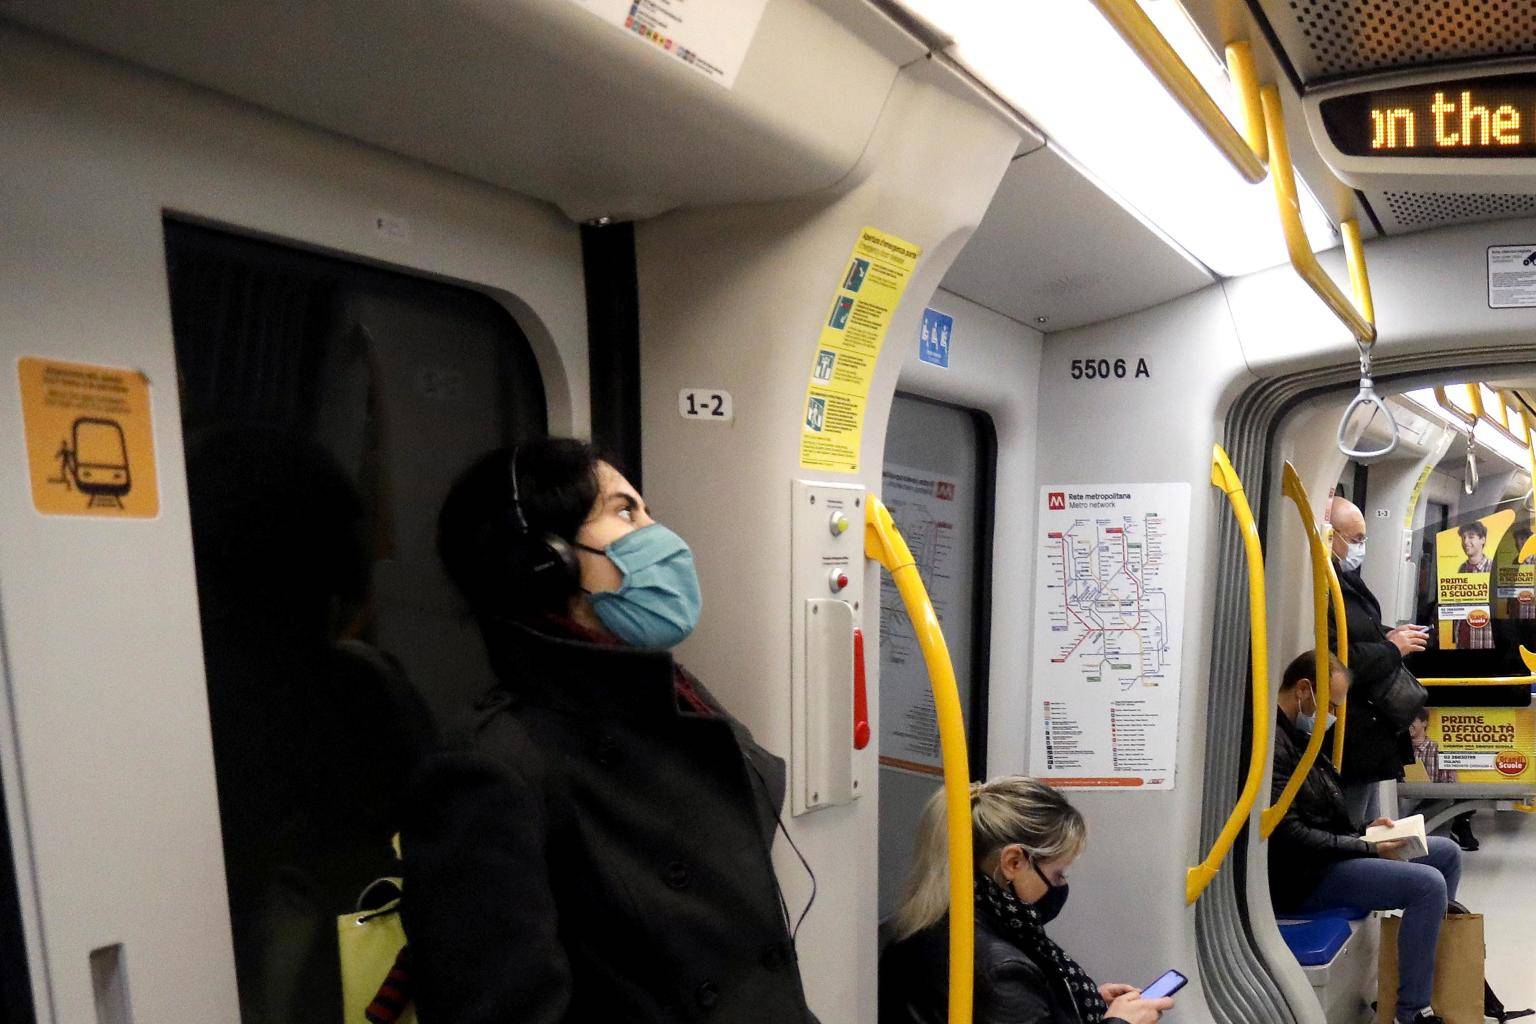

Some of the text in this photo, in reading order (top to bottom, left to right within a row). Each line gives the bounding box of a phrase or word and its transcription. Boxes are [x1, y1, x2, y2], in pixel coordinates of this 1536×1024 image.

[1432, 91, 1520, 146] the
[1071, 358, 1150, 379] 5506 A
[686, 393, 724, 416] 1-2
[1049, 494, 1065, 508] M
[1440, 582, 1488, 590] DIFFICOLTÀ
[1441, 716, 1484, 724] PRIME
[1442, 723, 1514, 733] DIFFICOLTÀ
[1443, 734, 1514, 742] A SCUOLA?
